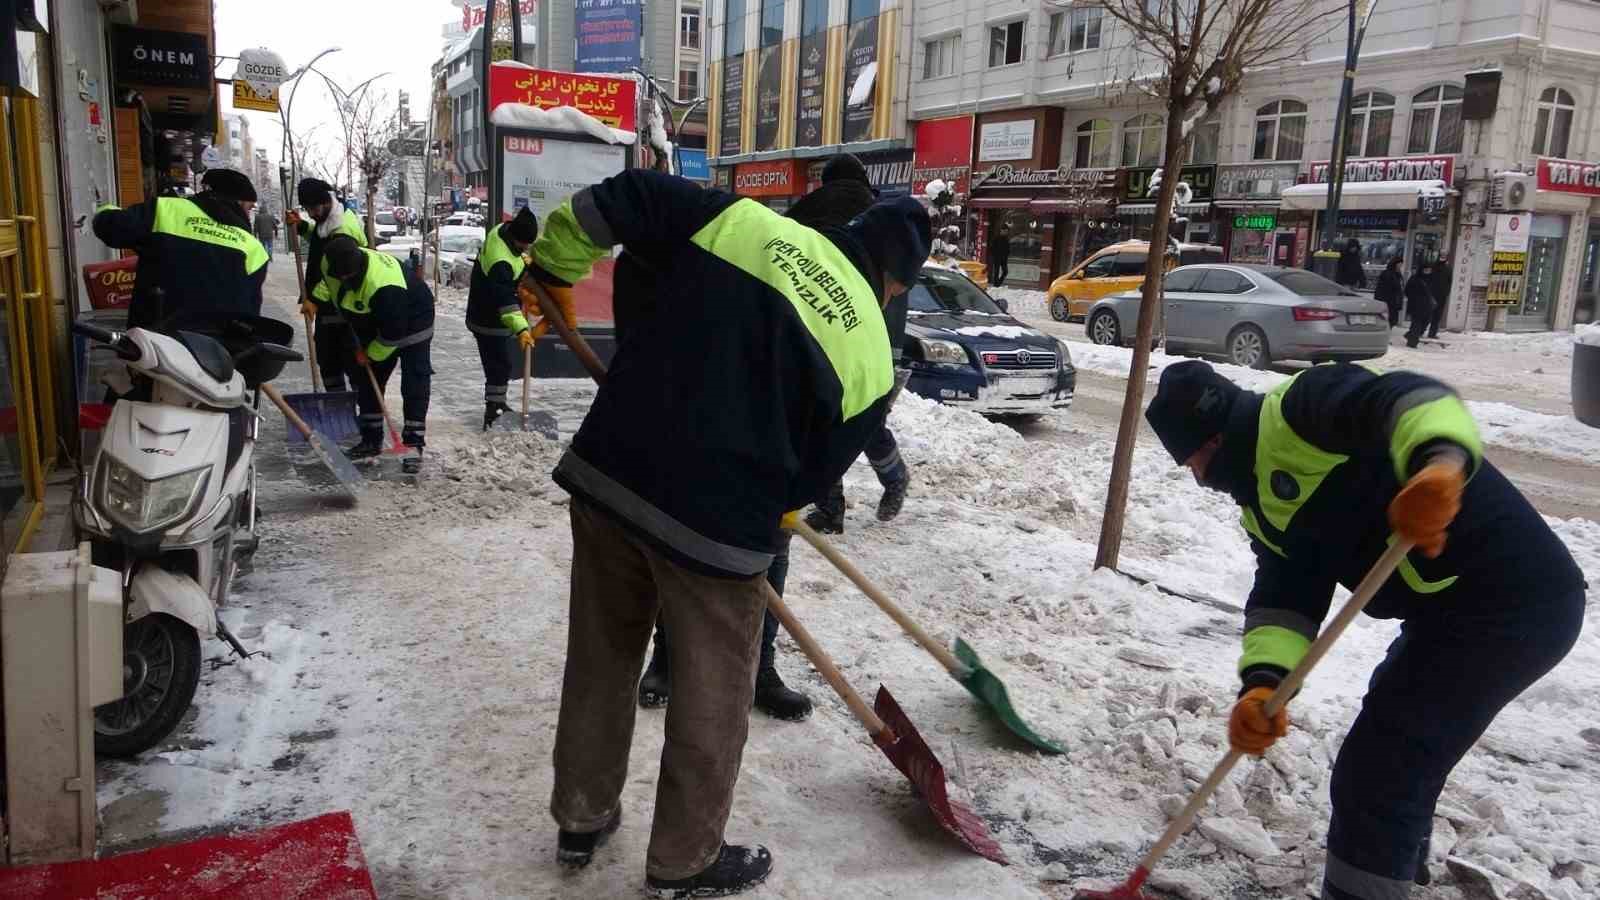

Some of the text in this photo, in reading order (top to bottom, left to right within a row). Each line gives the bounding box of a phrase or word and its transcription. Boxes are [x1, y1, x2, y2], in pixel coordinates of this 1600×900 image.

[997, 164, 1049, 184] Baklava
[1548, 162, 1580, 185] VAN
[771, 253, 839, 325] TEMİZLİK
[813, 270, 862, 333] BELEDİYESİ
